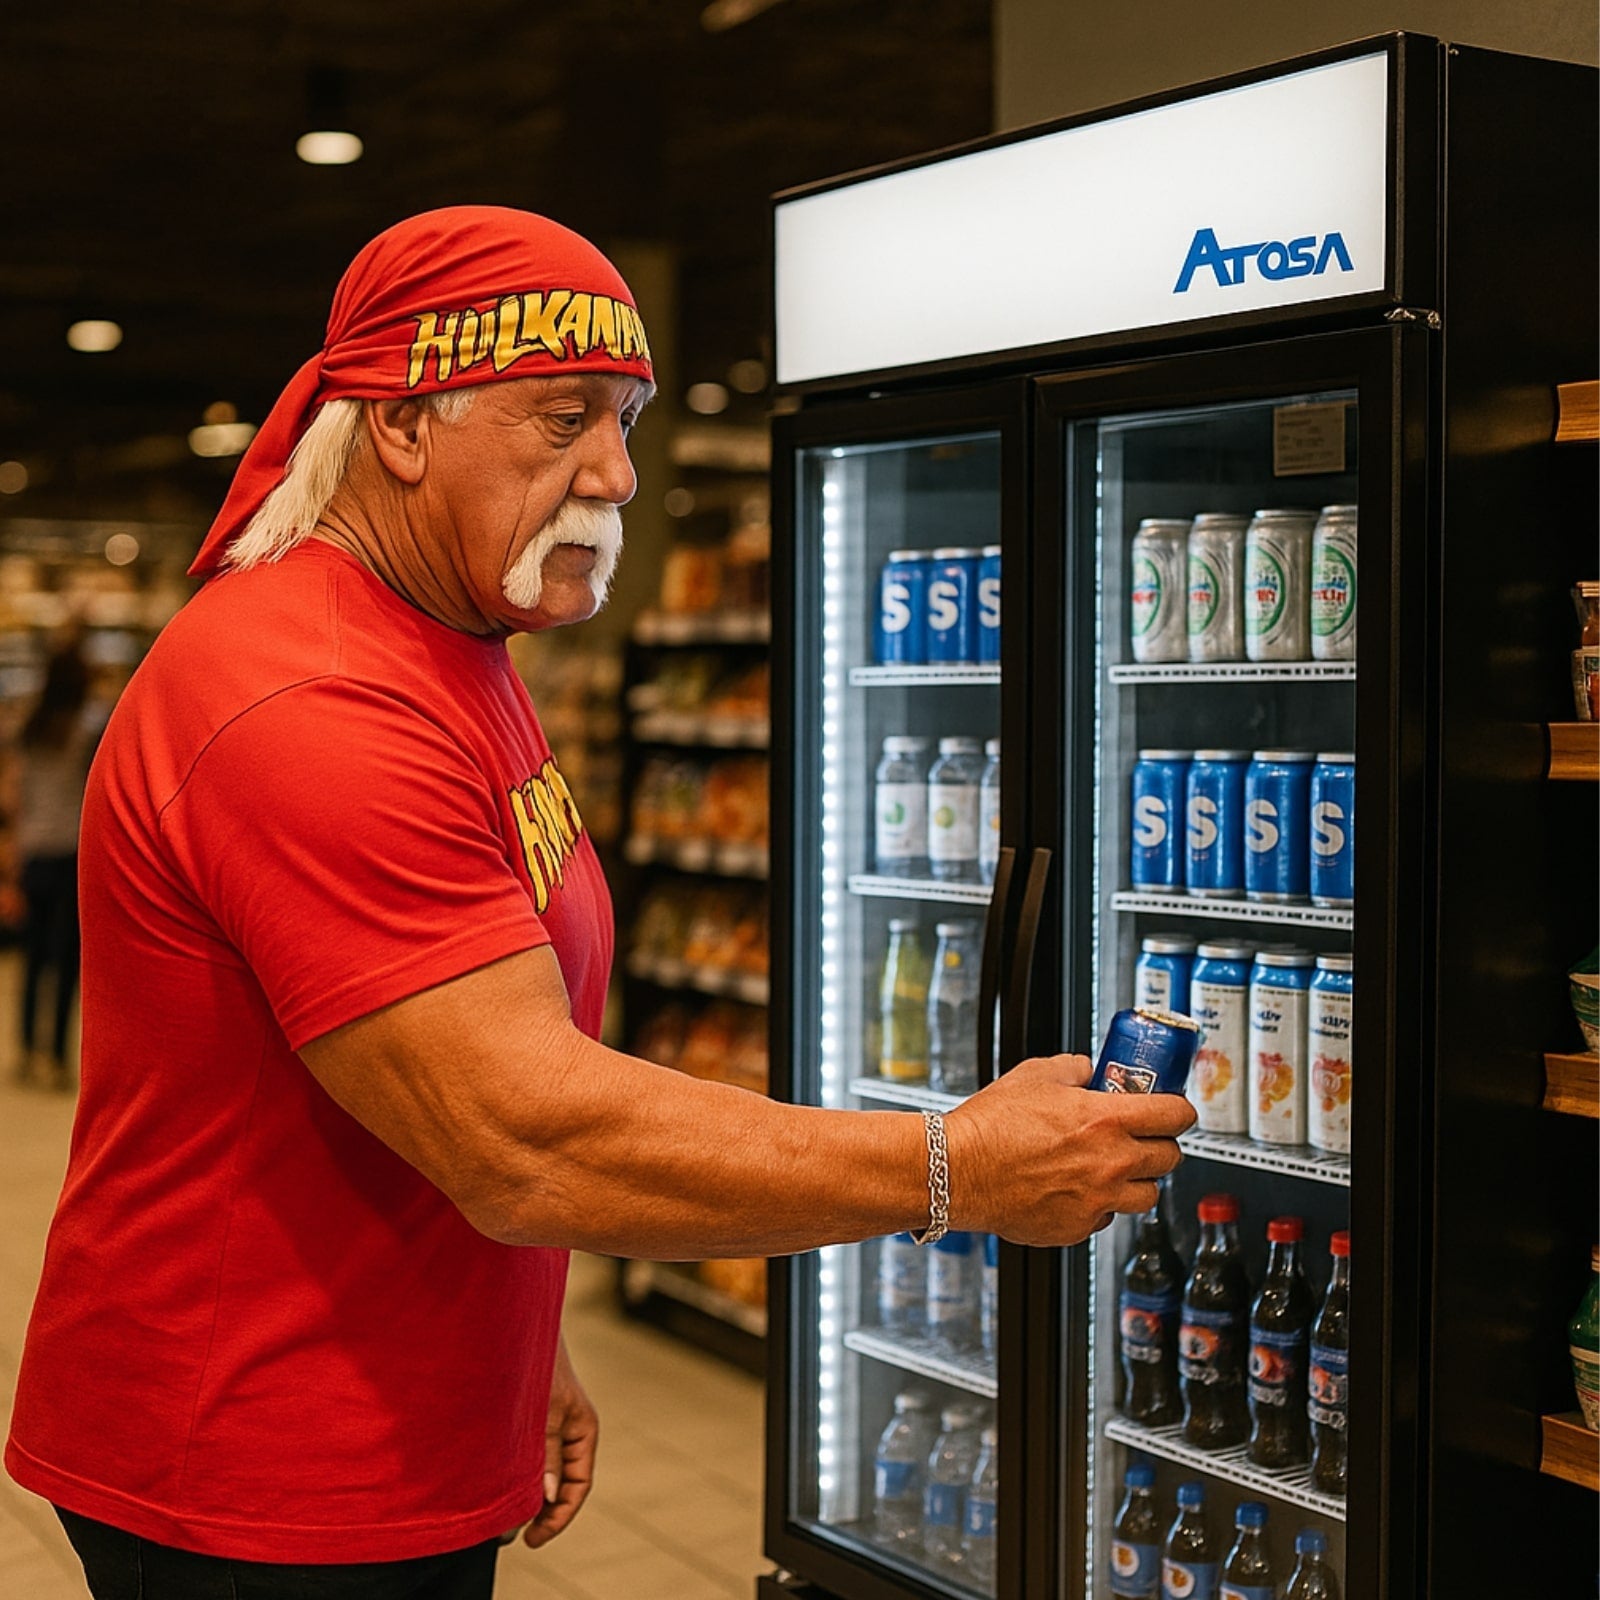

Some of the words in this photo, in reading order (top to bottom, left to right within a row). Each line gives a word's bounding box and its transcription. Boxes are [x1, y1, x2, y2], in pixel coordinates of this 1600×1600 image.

[1173, 228, 1354, 293] ATOSA
[882, 583, 910, 633] S
[928, 580, 958, 631] S
[978, 578, 1001, 628] S
[1134, 795, 1167, 848] S
[1187, 795, 1218, 850] S
[1246, 799, 1279, 854] S
[1312, 801, 1345, 857] S
